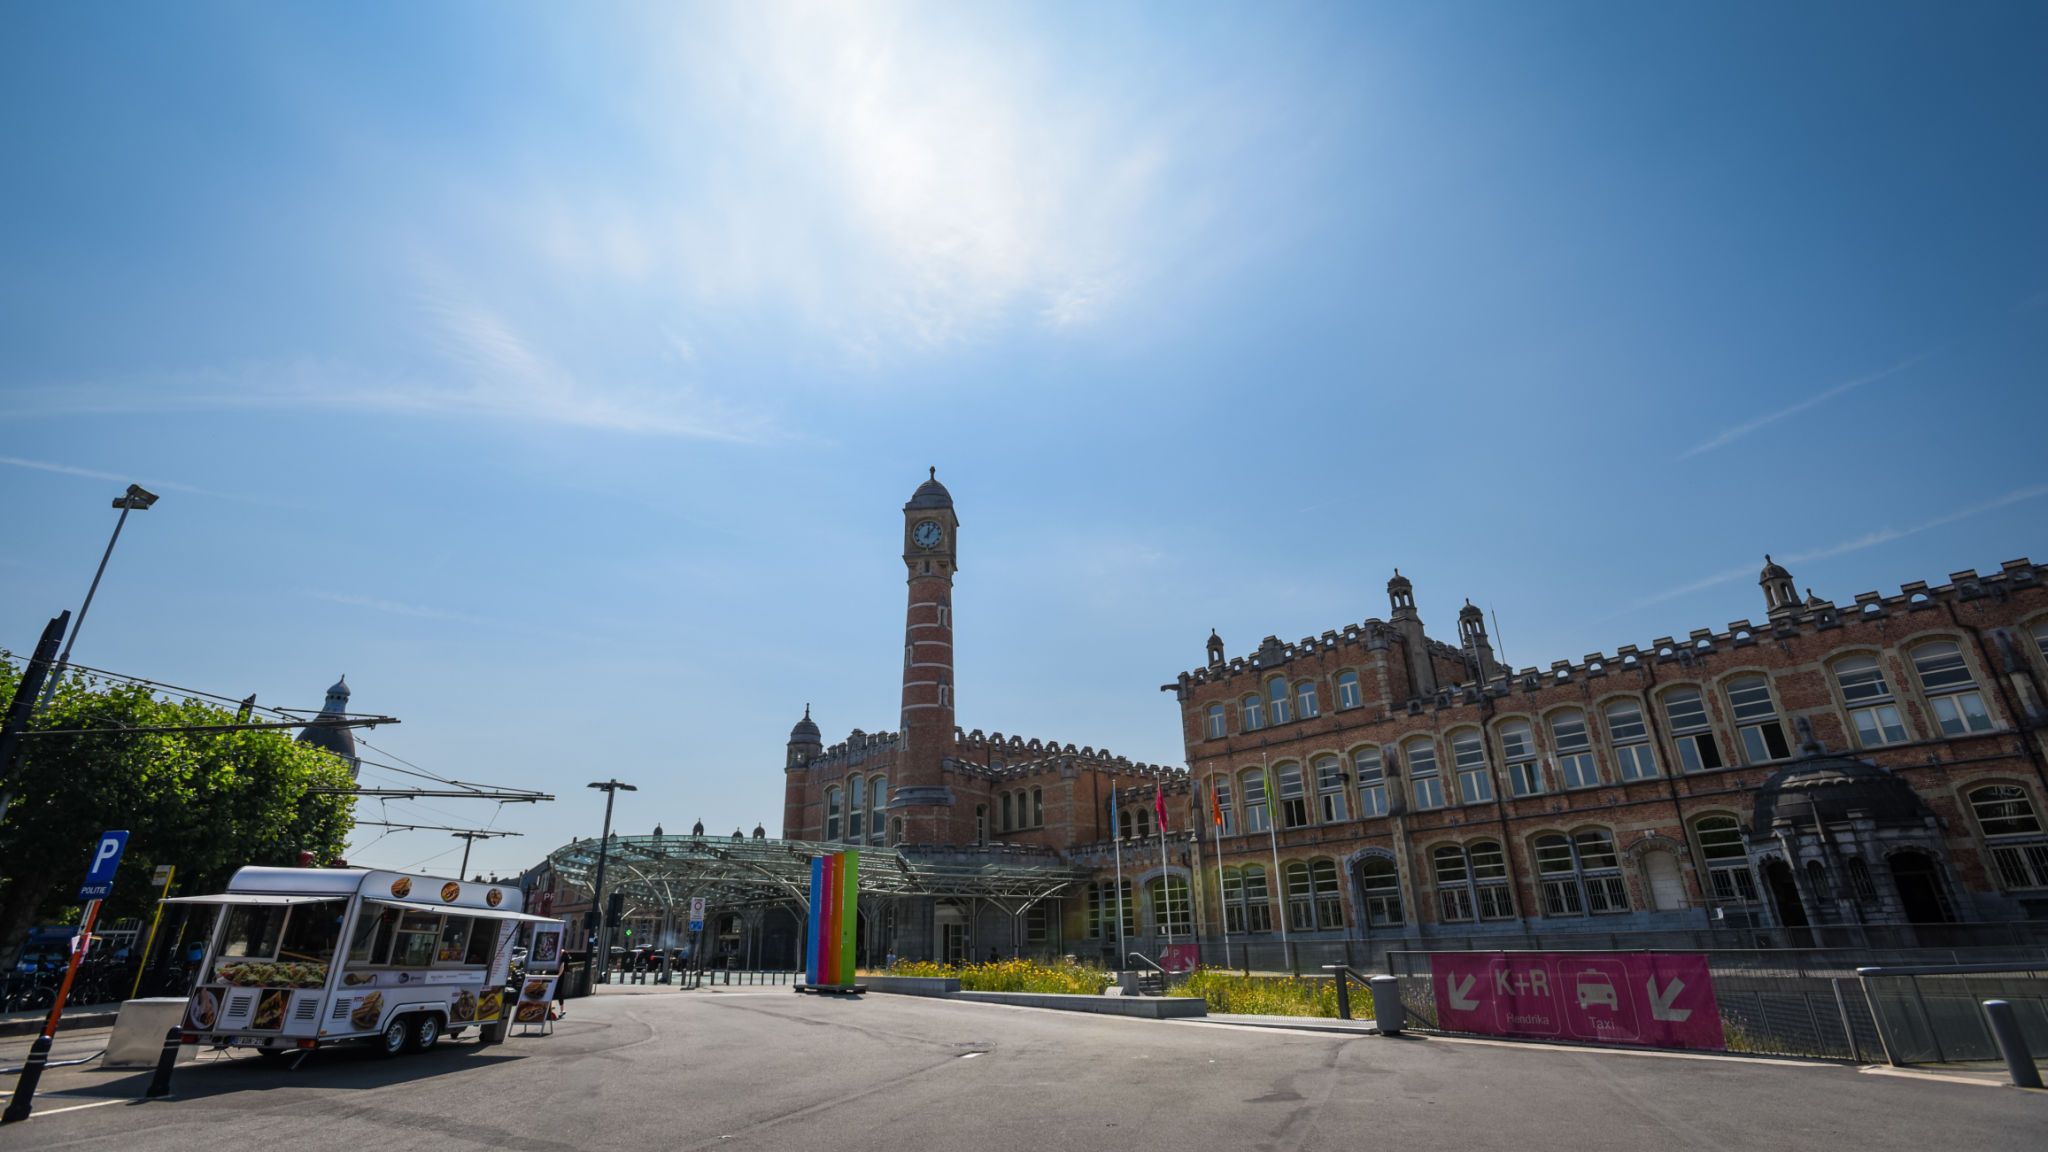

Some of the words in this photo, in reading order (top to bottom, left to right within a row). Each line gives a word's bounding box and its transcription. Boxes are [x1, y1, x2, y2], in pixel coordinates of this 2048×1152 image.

[91, 838, 119, 873] P
[80, 886, 107, 894] POLITIE
[1494, 968, 1550, 997] K+R
[1506, 1012, 1550, 1025] Hendrika
[1588, 1016, 1616, 1030] Taxi
